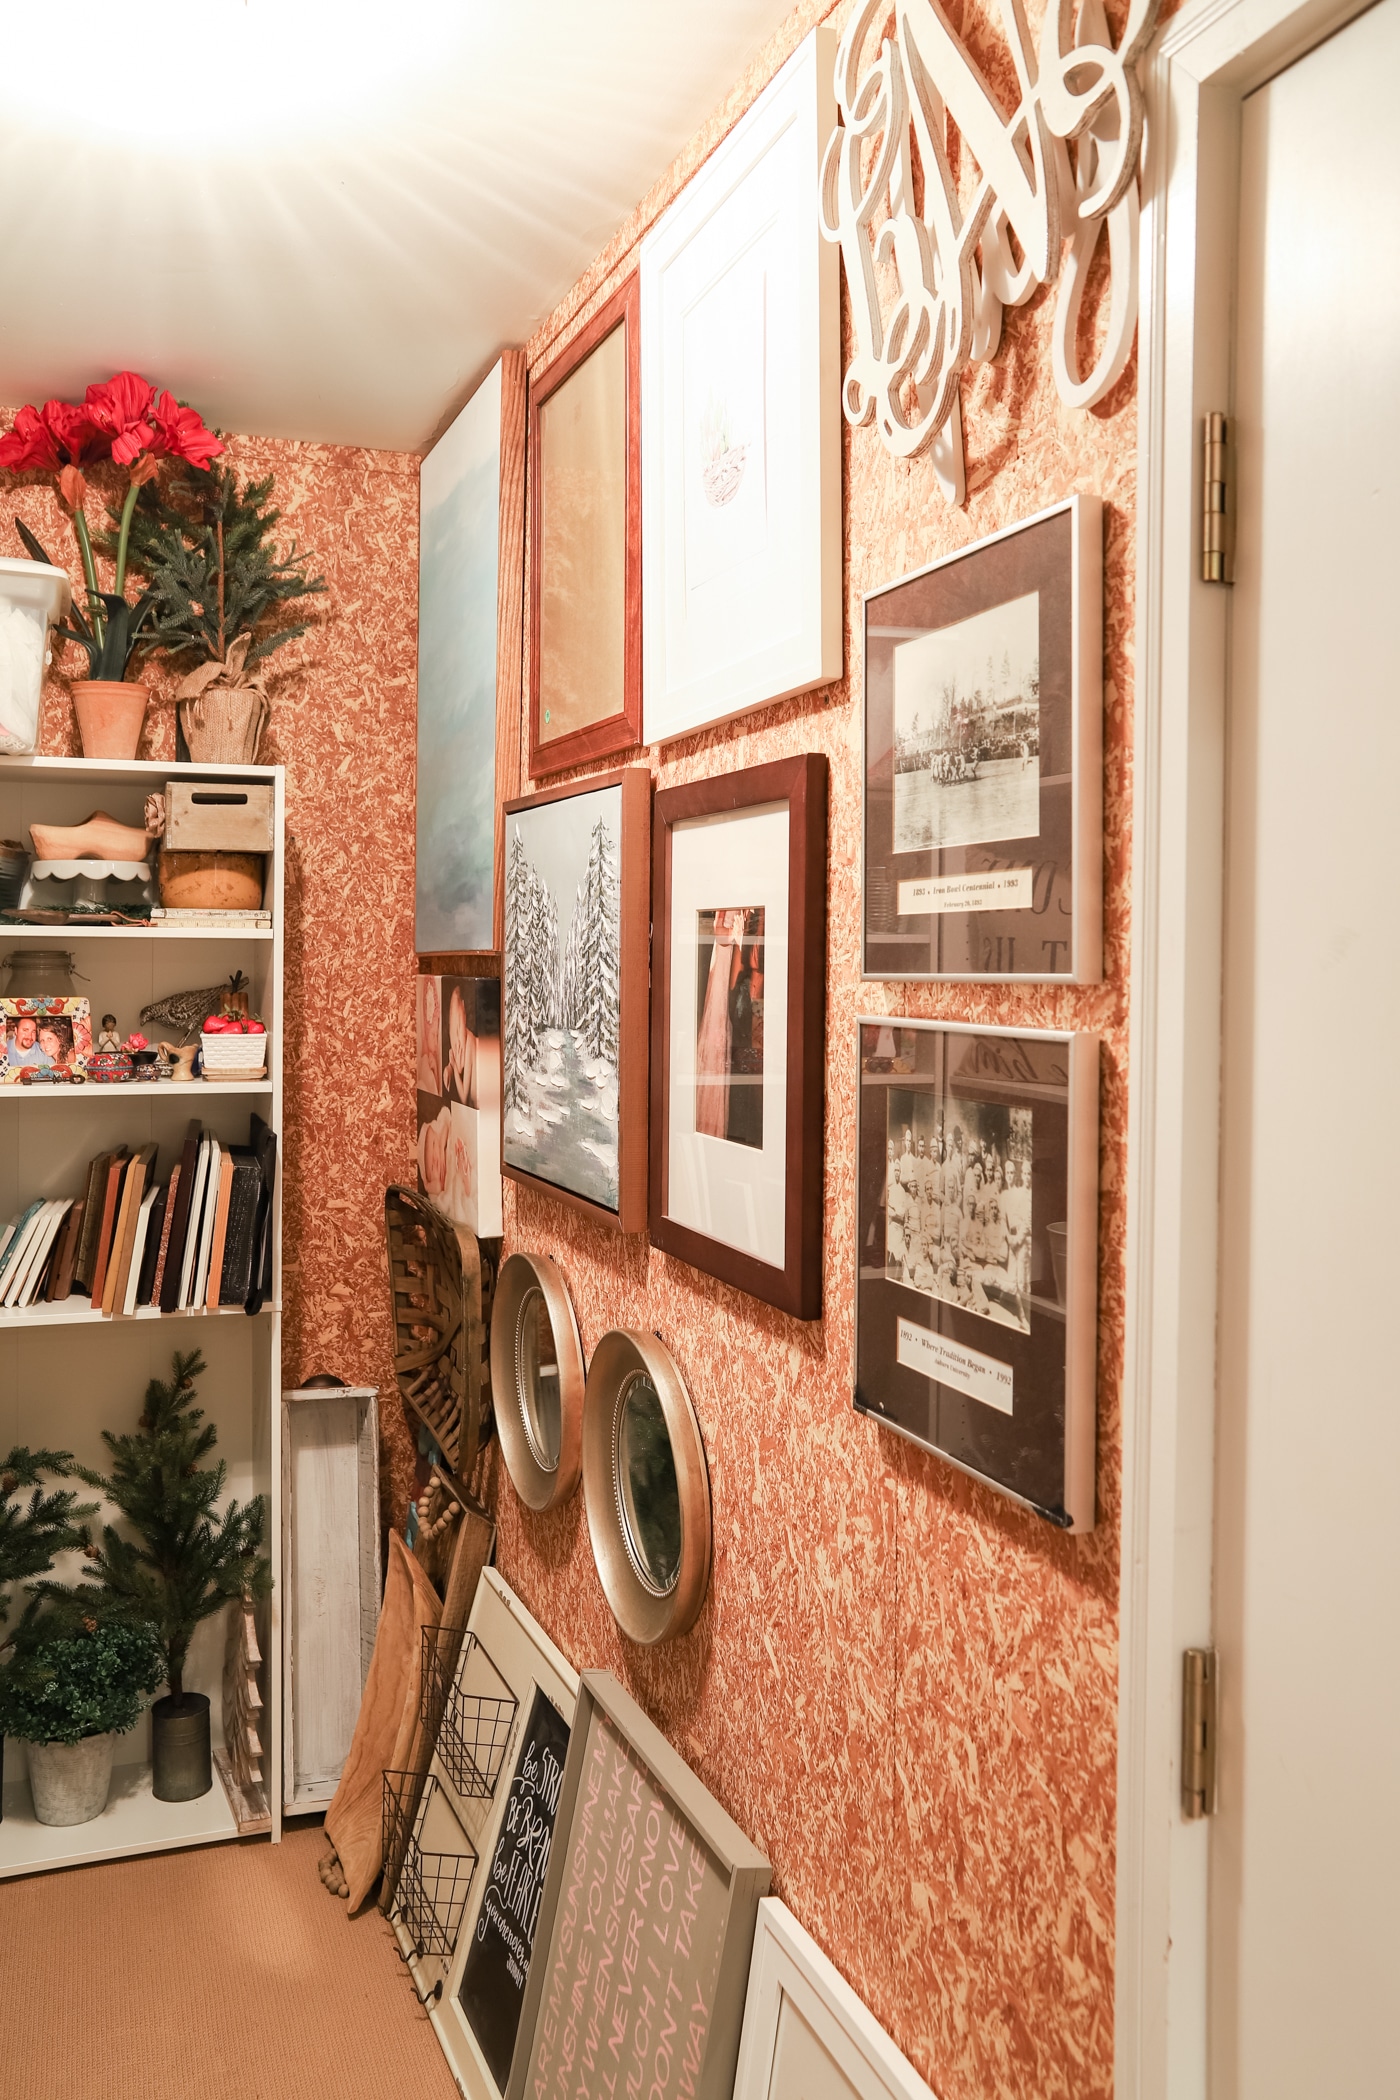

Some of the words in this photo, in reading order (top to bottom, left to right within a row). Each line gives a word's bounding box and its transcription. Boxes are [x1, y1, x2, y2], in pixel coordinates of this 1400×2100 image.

[933, 886, 946, 895] Iron
[947, 884, 961, 894] Bowl
[962, 881, 995, 892] Centennial
[900, 1329, 913, 1342] 1892
[921, 1338, 939, 1353] Where
[940, 1347, 967, 1365] Tradition
[967, 1358, 986, 1375] Began
[997, 1371, 1012, 1386] 1992
[506, 1796, 521, 1834] BE
[561, 1762, 602, 1954] SUNSHINE
[503, 1850, 543, 1950] FEARLE
[584, 1849, 608, 1936] YOU
[652, 1809, 687, 1946] LOVE
[673, 1837, 708, 1961] TAKE
[582, 1941, 614, 2073] WHEN
[605, 1827, 635, 1948] SKIES
[608, 1907, 645, 2063] NEVER
[648, 1955, 660, 1979] I
